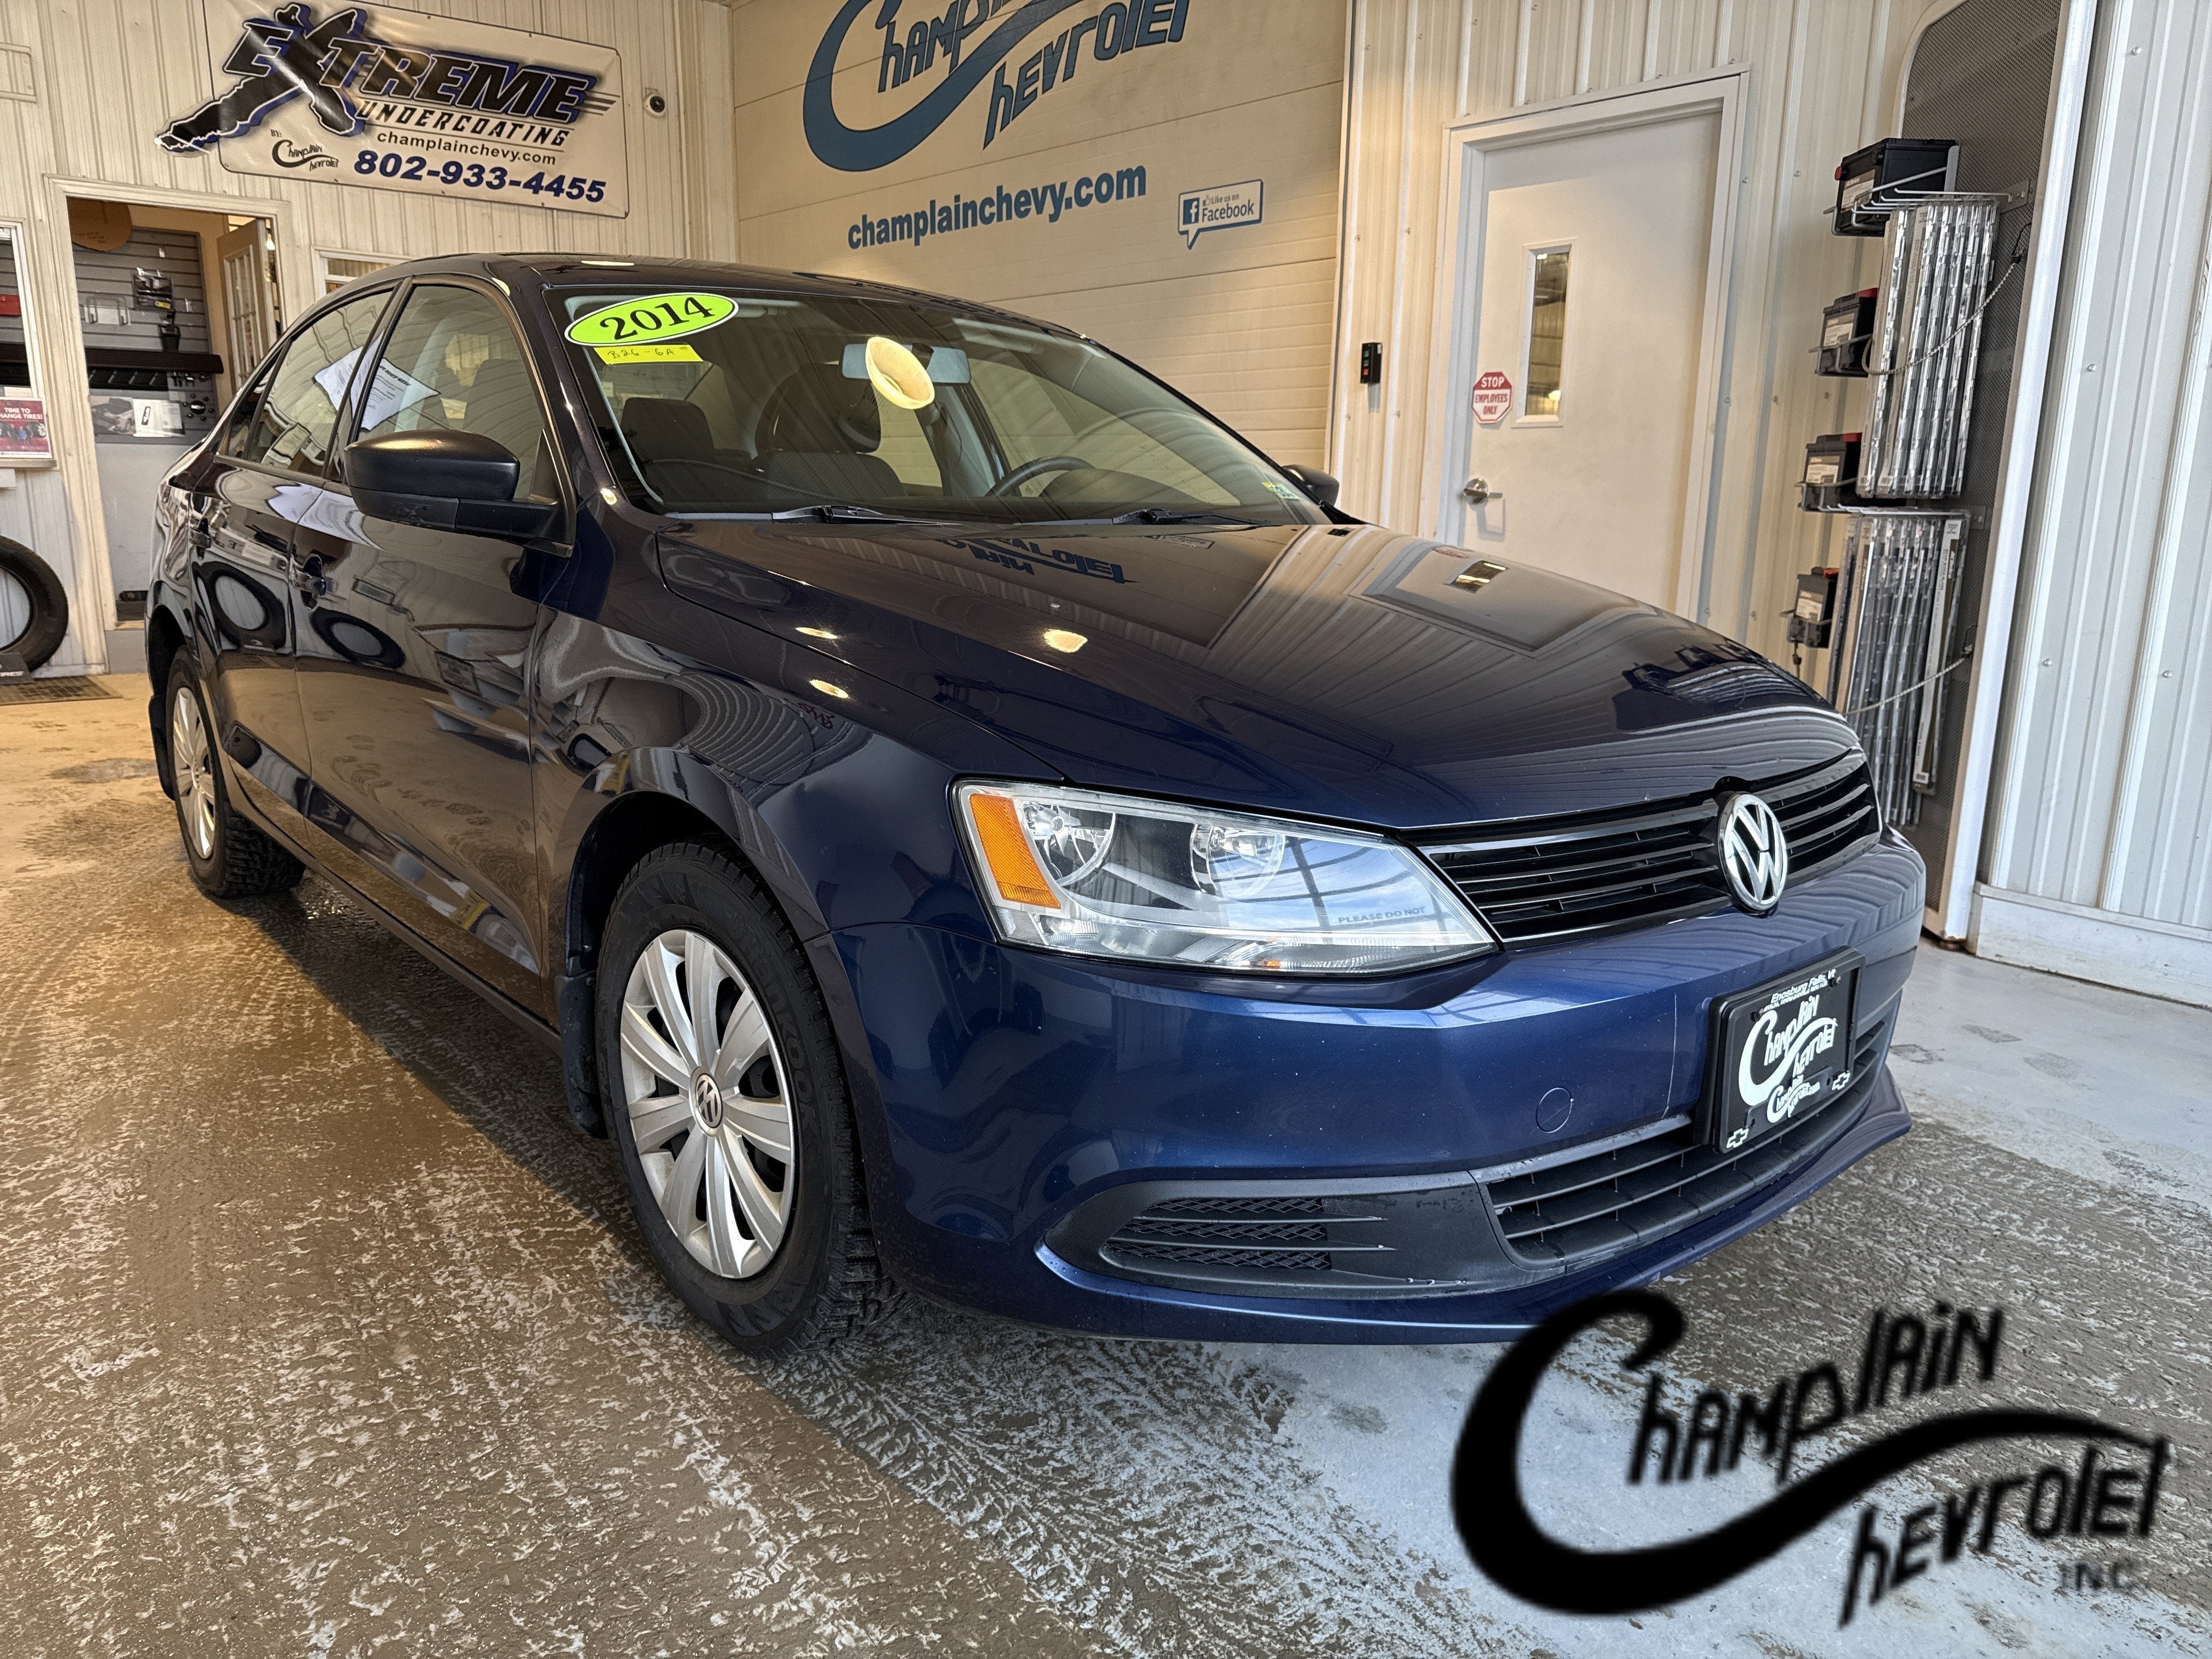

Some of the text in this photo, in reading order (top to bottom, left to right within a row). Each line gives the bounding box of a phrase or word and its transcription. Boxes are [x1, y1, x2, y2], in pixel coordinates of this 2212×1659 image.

[355, 100, 570, 146] UNDERCOATING
[377, 132, 556, 165] champlainchevy.com
[354, 150, 607, 202] 802-933-4455
[848, 165, 1147, 249] champlainchevy.com
[1201, 199, 1255, 222] Facebook
[1211, 195, 1223, 204] Like
[600, 297, 715, 340] 2014
[1481, 376, 1505, 388] STOP
[1475, 394, 1508, 403] EMPLOYEES
[1483, 405, 1498, 415] ONLY
[1338, 906, 1425, 924] PLEASE DO NOT
